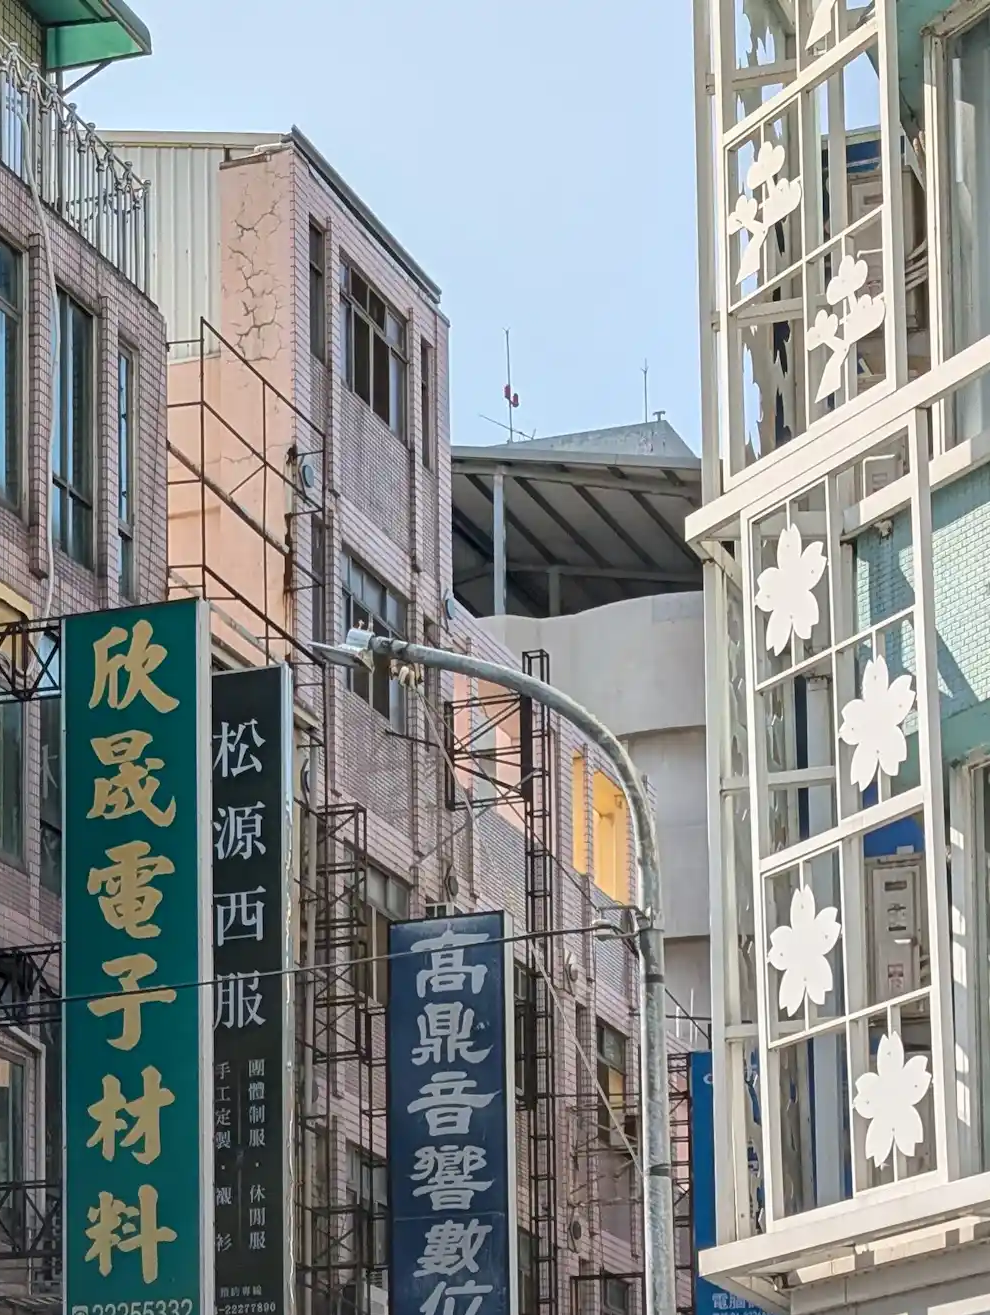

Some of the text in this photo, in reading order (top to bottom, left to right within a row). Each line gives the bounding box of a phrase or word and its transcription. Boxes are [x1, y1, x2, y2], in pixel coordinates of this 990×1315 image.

[84, 619, 180, 1284] 欣晟電子材料
[213, 719, 266, 1030] 松源西服
